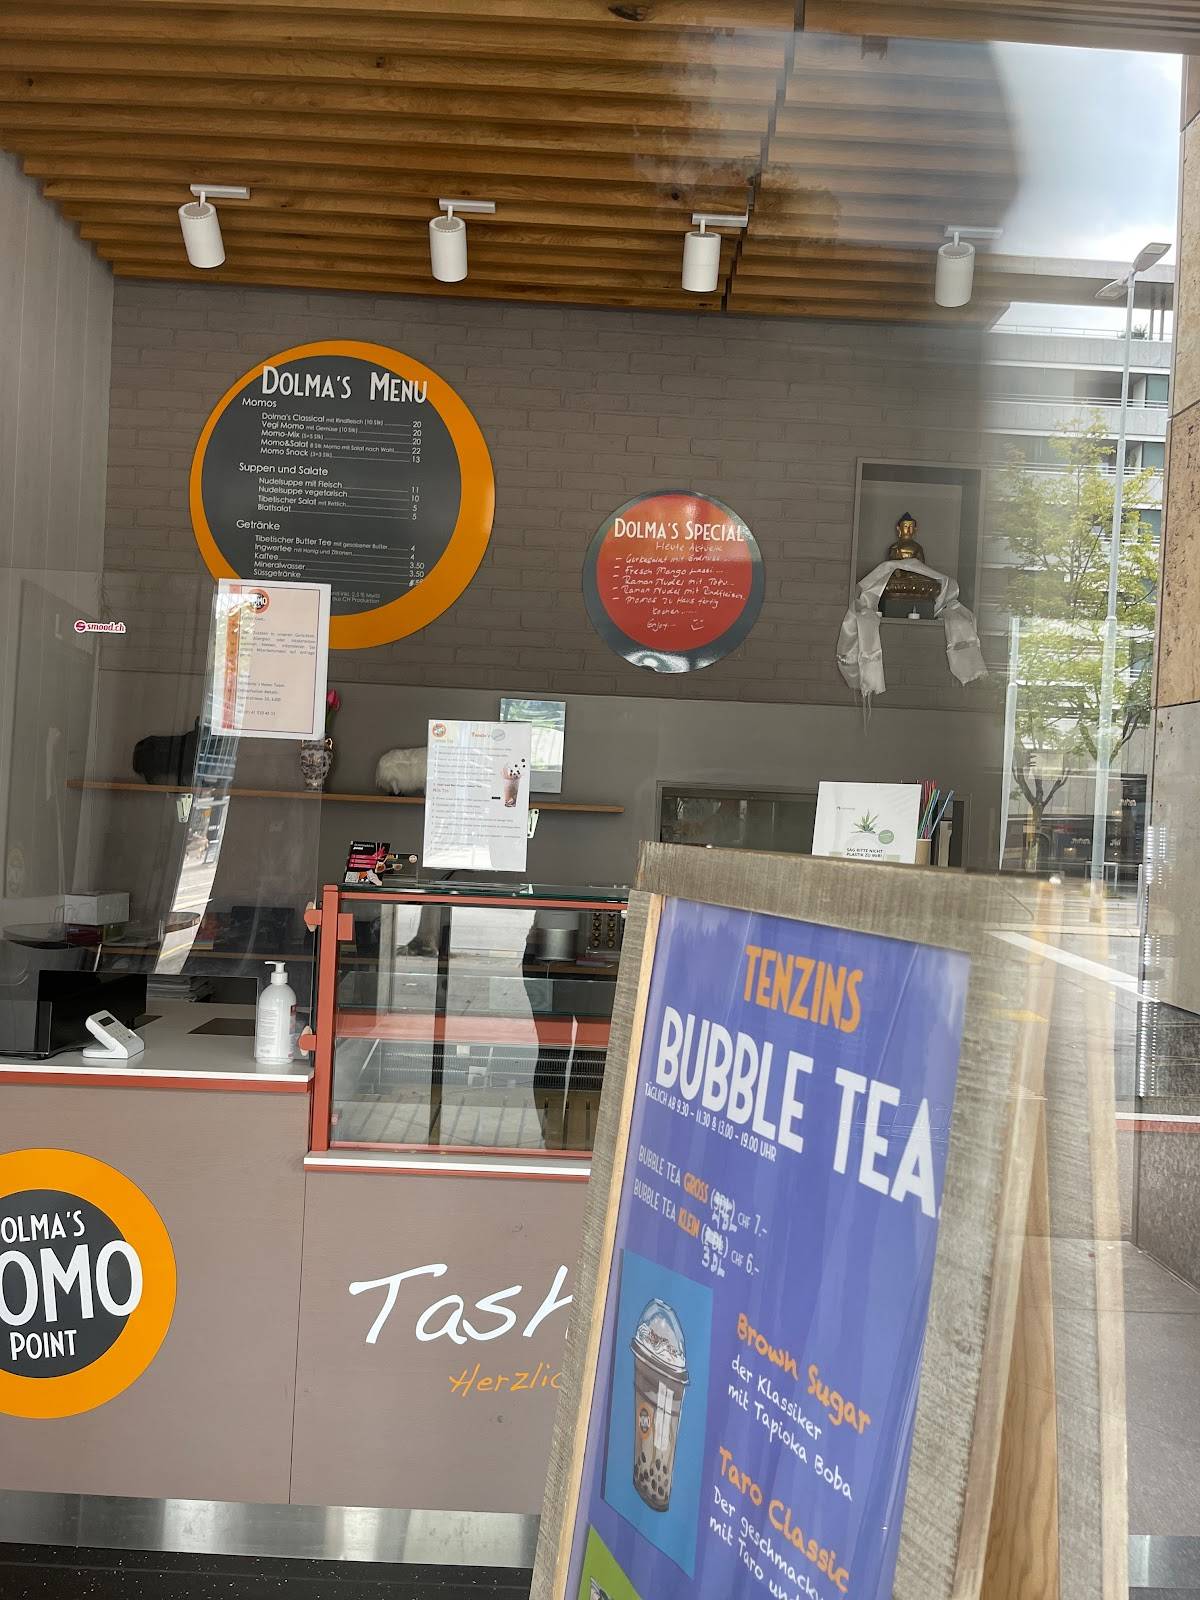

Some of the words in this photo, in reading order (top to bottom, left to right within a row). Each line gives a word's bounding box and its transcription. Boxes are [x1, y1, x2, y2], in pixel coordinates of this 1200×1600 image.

[262, 365, 351, 399] DOLMA'S
[370, 372, 428, 403] MENU
[242, 398, 277, 408] Momos
[262, 412, 291, 420] Dolma's
[293, 414, 325, 423] Classical
[262, 421, 279, 430] Vegi
[281, 422, 304, 430] Momo
[261, 429, 300, 438] Momo-Mix
[261, 438, 308, 448] Momo&Salat
[260, 447, 284, 455] Momo
[286, 448, 308, 457] Snack
[412, 456, 421, 464] 13
[239, 462, 275, 474] Suppen
[278, 466, 296, 474] und
[298, 466, 329, 476] Salate
[259, 477, 304, 487] Nudelsuppe
[318, 480, 343, 489] Fleisch
[412, 486, 419, 494] 11
[259, 486, 303, 495] Nudelsuppe
[304, 489, 348, 498] vegetarisch
[258, 495, 297, 504] Tibetischer
[298, 497, 317, 505] Salat
[413, 504, 418, 512] 5
[258, 504, 291, 513] Blattsalat
[236, 520, 280, 531] Getränke
[614, 518, 679, 540] DOLMA'S
[685, 521, 744, 542] SPECIAL
[255, 535, 294, 544] Tibetischer
[296, 537, 317, 545] Butter
[255, 544, 292, 552] Ingwertee
[254, 552, 279, 560] Kaffee
[410, 562, 425, 570] 3.50
[254, 561, 306, 570] Mineralwasser
[409, 570, 425, 578] 3.50
[253, 569, 301, 578] Süssgetränke
[656, 567, 686, 578] Mango
[684, 587, 699, 595] mit
[744, 944, 863, 1033] TENZINS
[656, 1006, 814, 1153] BUBBLE
[833, 1067, 936, 1218] TEA
[645, 1082, 668, 1106] TÄGLICH
[668, 1095, 676, 1110] AB
[677, 1099, 689, 1117] 9.30
[696, 1110, 710, 1130] 11.30
[718, 1121, 734, 1140] 13.00
[741, 1132, 758, 1153] 19.00
[760, 1141, 777, 1162] UHR
[639, 1145, 665, 1176] BUBBLE
[667, 1162, 681, 1186] TEA
[684, 1172, 709, 1203] GROSS
[738, 1212, 751, 1229] CHF
[634, 1178, 660, 1211] BUBBLE
[662, 1197, 676, 1222] TEA
[678, 1207, 701, 1239] KLEIN
[731, 1250, 744, 1267] CHF
[9, 1329, 77, 1360] POINT
[737, 1312, 799, 1381] Brown
[808, 1364, 871, 1435] Sugar
[731, 1354, 753, 1384] der
[757, 1376, 823, 1442] Klassiker
[728, 1383, 749, 1412] mit
[754, 1402, 808, 1465] Tapioka
[814, 1454, 853, 1501] Boba
[714, 1485, 736, 1518] Der
[719, 1445, 763, 1507] Taro
[768, 1499, 849, 1594] Classic
[710, 1515, 733, 1546] mit
[738, 1539, 764, 1581] Taro
